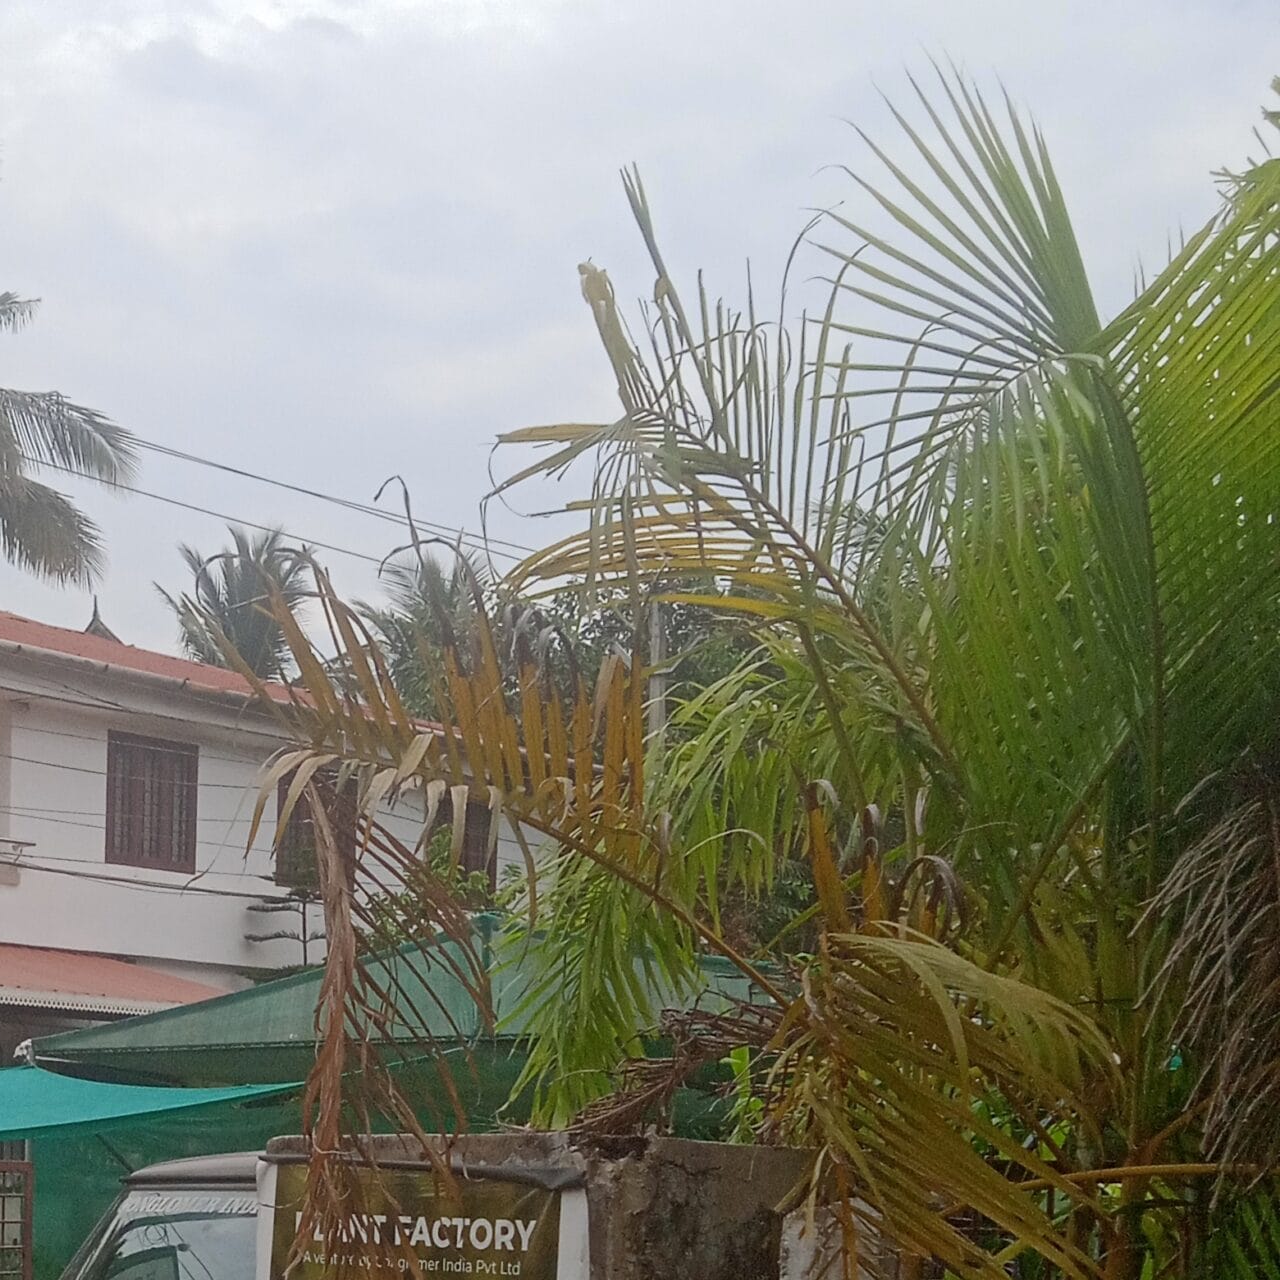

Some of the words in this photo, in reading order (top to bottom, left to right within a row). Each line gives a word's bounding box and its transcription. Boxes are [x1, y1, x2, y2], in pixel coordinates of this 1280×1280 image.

[394, 1215, 537, 1252] FACTORY
[442, 1257, 473, 1274] India
[476, 1258, 498, 1275] Pvt
[500, 1260, 521, 1276] Ltd
